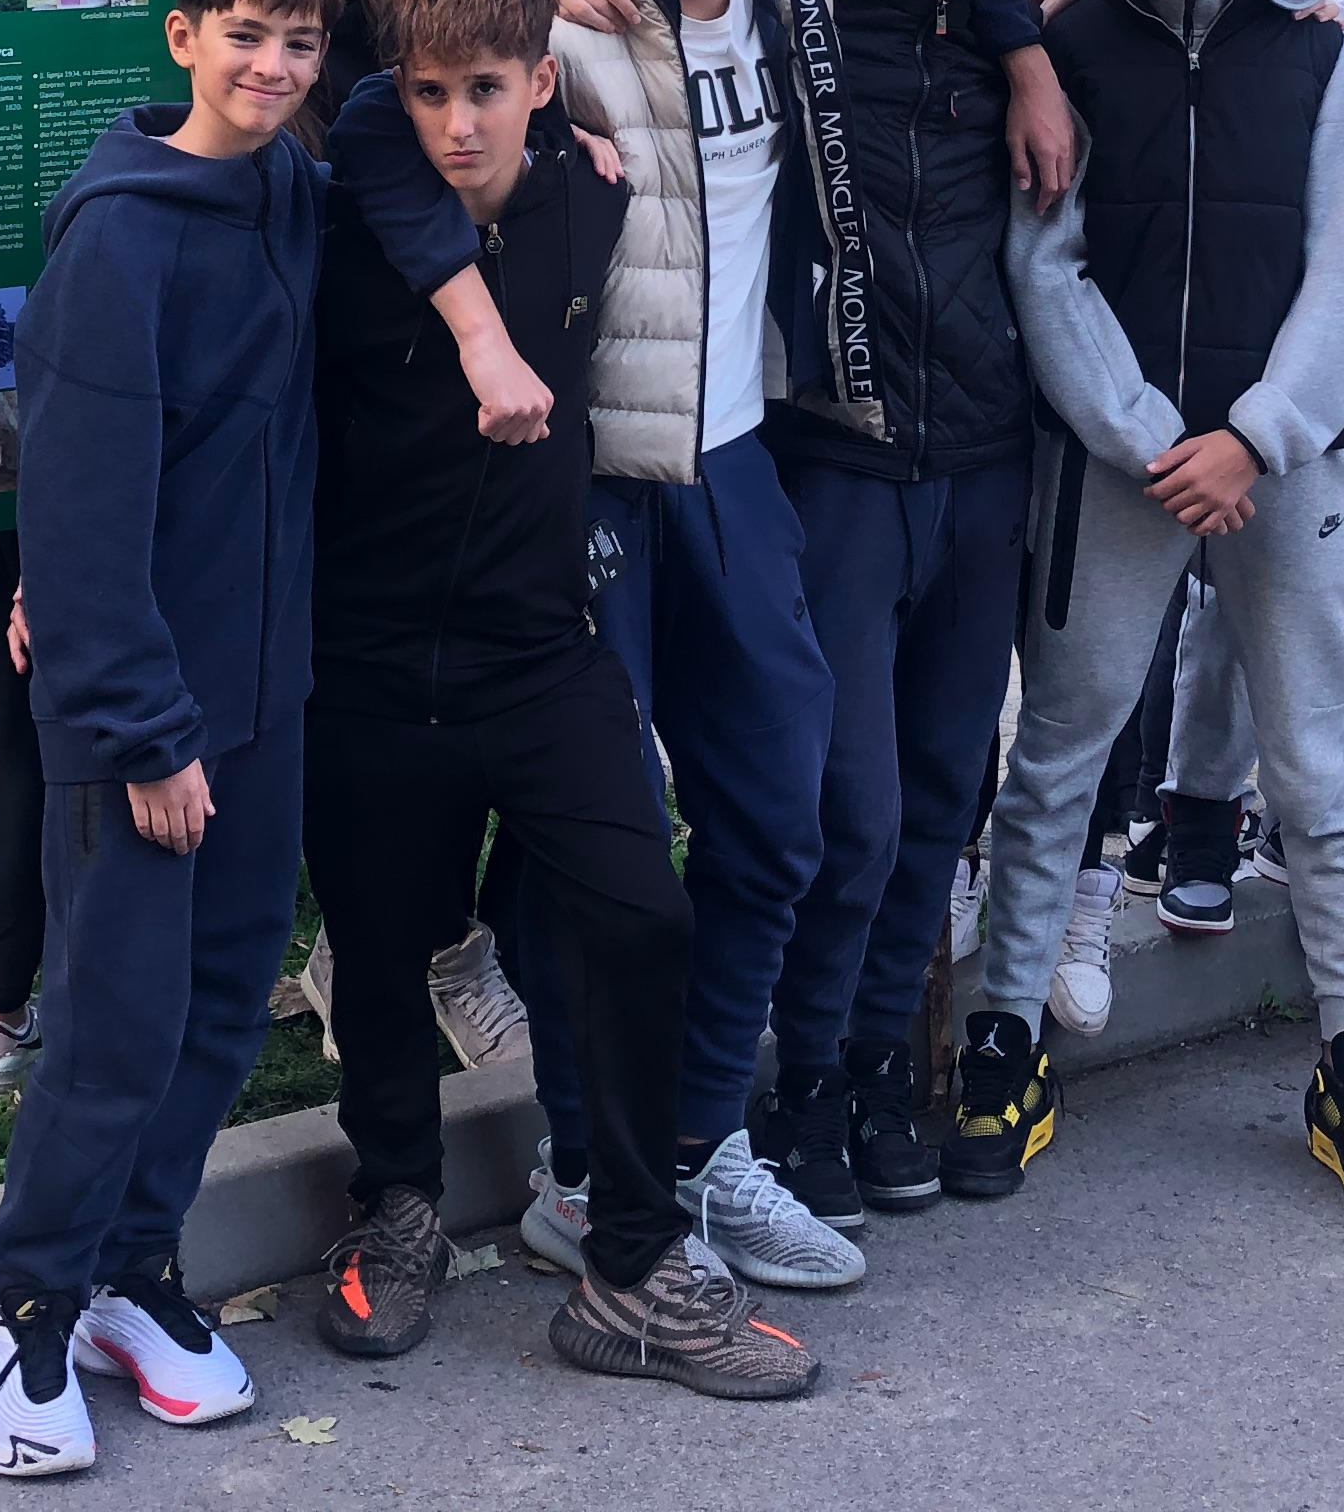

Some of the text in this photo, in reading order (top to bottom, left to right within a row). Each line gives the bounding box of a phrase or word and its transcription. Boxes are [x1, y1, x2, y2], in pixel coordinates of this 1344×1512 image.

[686, 57, 785, 138] OLO
[704, 136, 766, 161] LPH LAUREN
[818, 111, 860, 254] MONCLER
[842, 268, 873, 404] MONCLE
